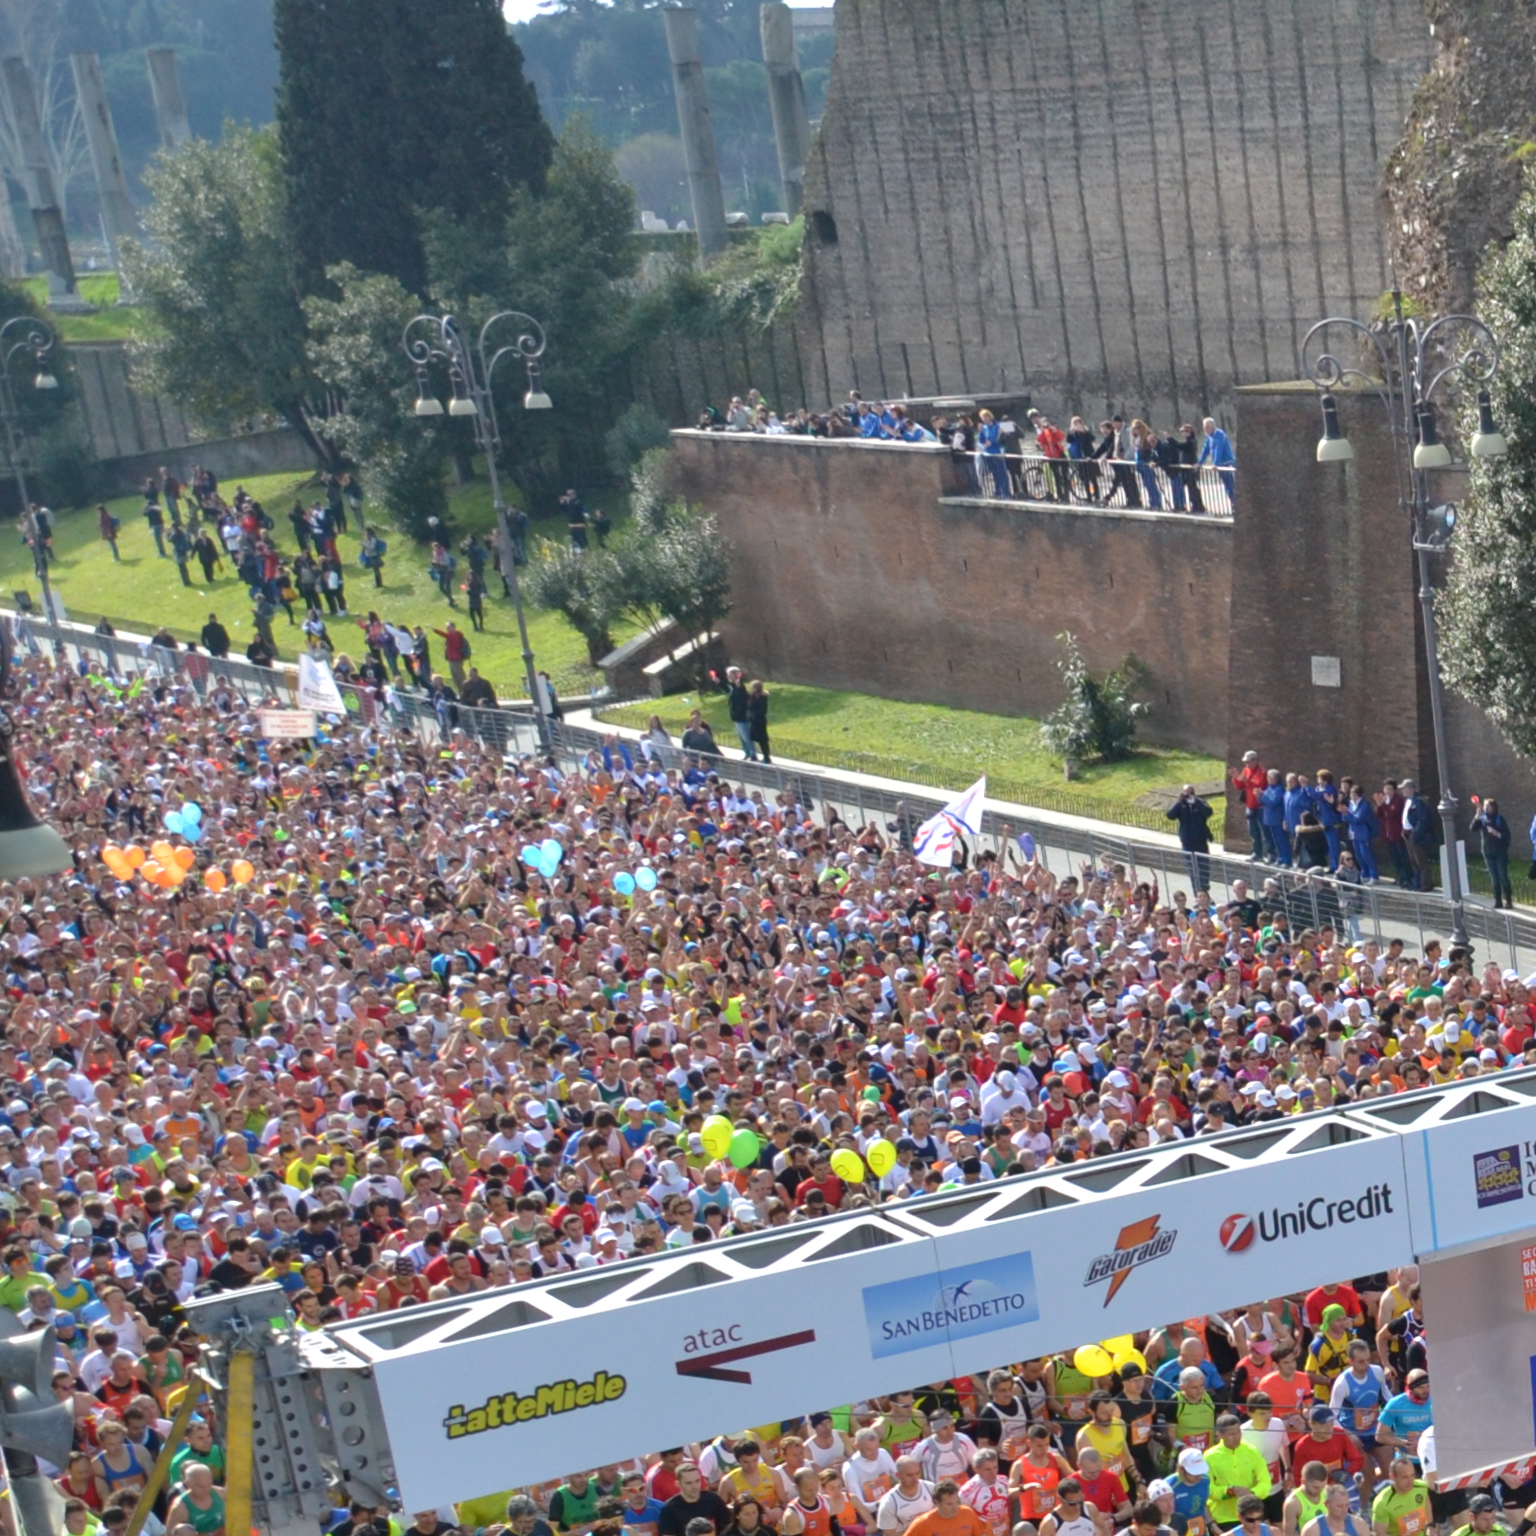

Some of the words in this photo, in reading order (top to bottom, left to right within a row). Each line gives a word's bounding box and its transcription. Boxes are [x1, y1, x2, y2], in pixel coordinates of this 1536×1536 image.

[1258, 1183, 1394, 1242] UniCredit
[1087, 1230, 1176, 1281] Gatorade
[1522, 1248, 1532, 1259] SE
[1524, 1278, 1533, 1288] TI
[684, 1322, 743, 1353] atac
[448, 1371, 626, 1439] LatteMiele
